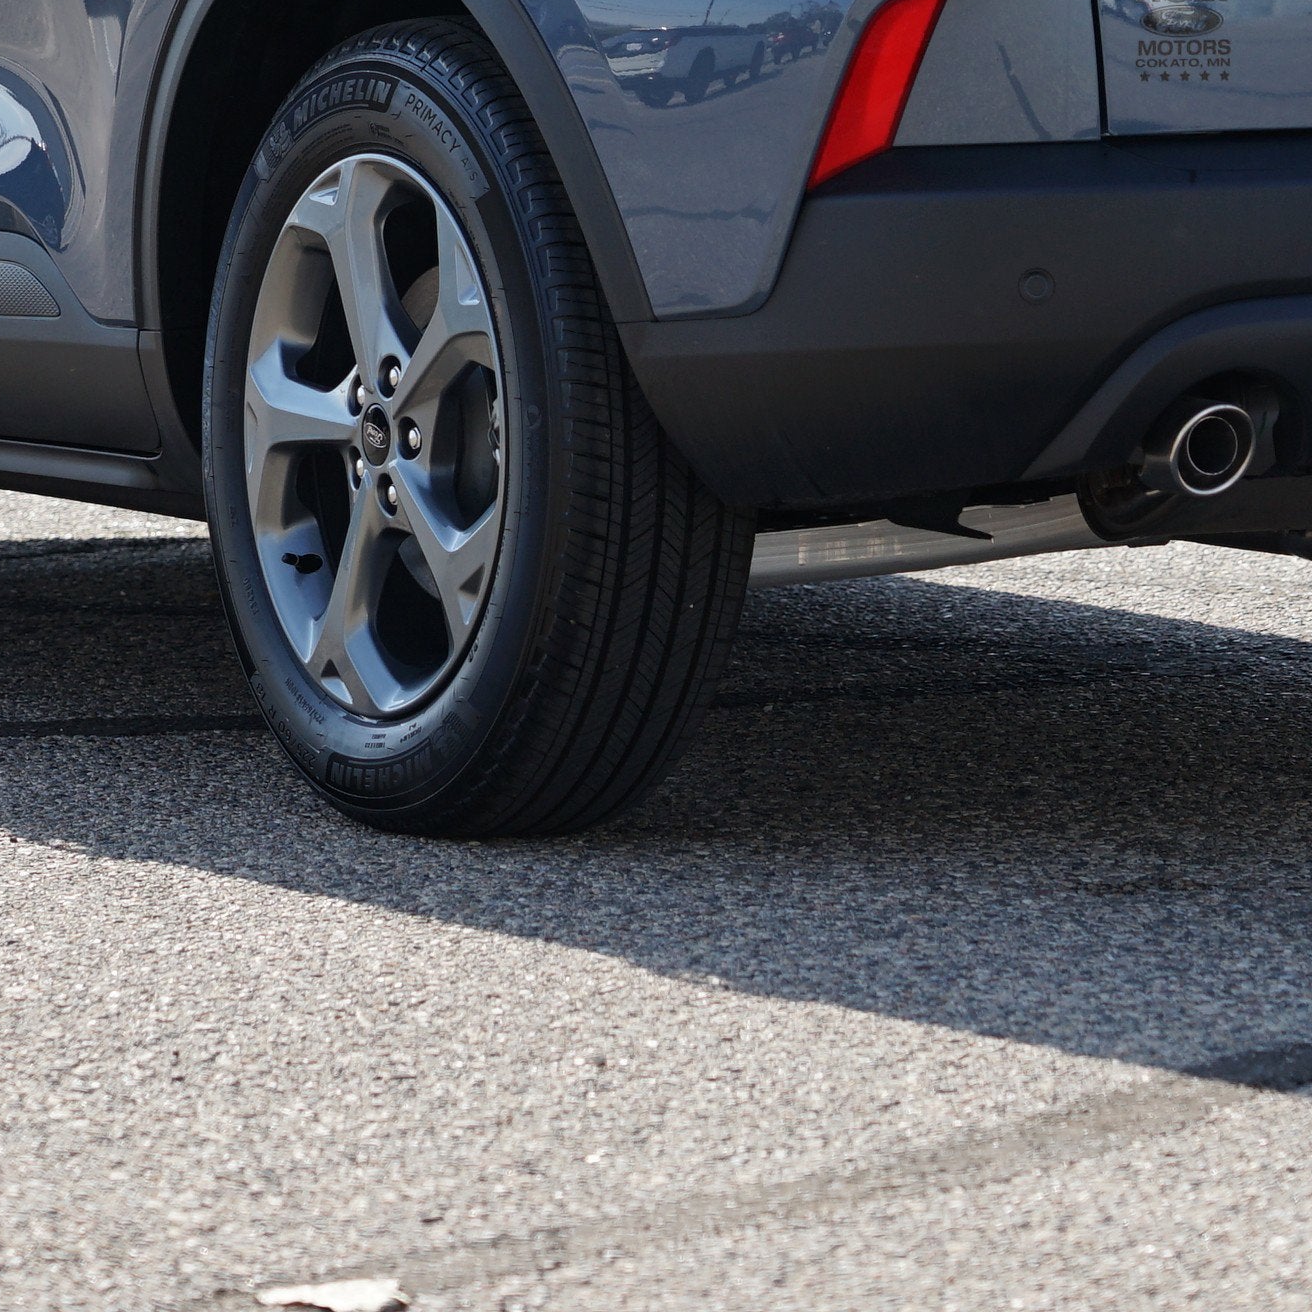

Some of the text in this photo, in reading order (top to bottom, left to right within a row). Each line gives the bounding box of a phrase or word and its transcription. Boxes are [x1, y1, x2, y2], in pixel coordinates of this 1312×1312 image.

[1137, 39, 1232, 56] MOTORS
[1135, 58, 1231, 68] COKATO, MN
[293, 79, 392, 130] MICHELIN
[404, 93, 461, 154] PRIMACY
